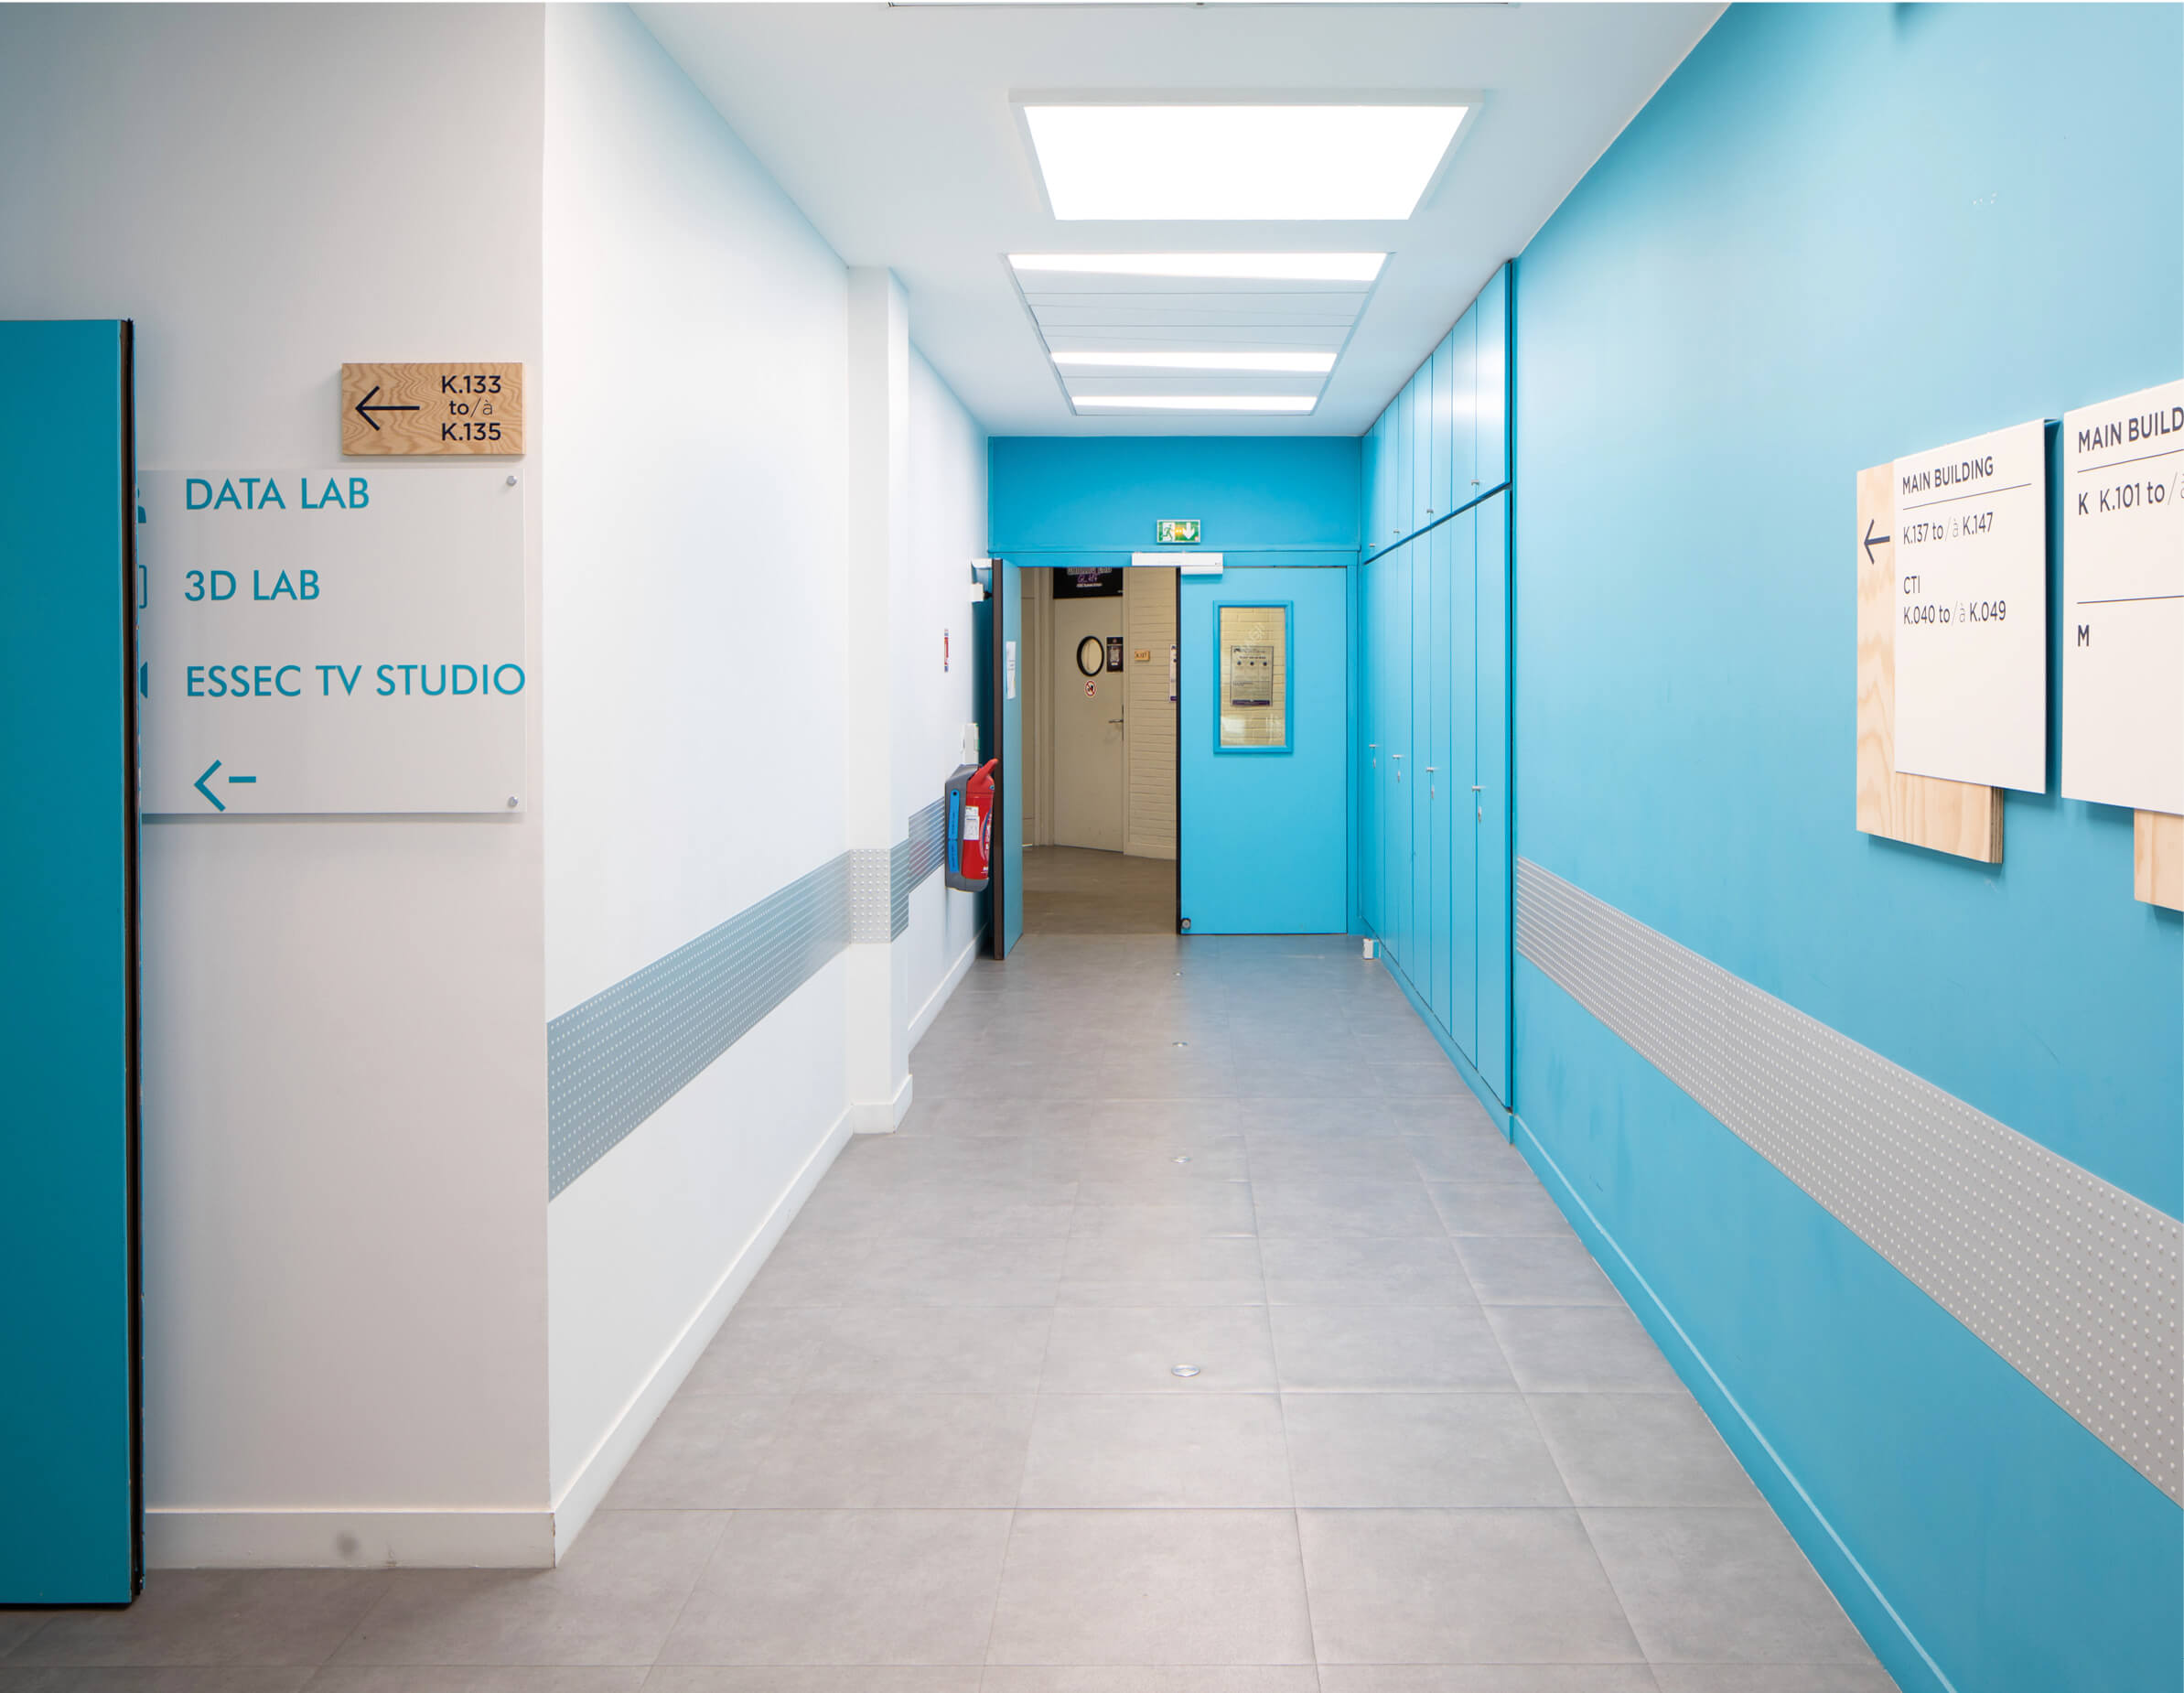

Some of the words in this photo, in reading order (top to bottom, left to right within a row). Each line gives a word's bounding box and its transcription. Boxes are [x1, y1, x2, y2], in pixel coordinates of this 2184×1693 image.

[441, 374, 501, 394] K.133
[441, 421, 501, 442] K.135
[2078, 420, 2123, 454] MAIN
[1902, 470, 1931, 495] MAIN
[1934, 455, 1995, 489] BUILDING
[186, 477, 286, 510] DATA
[300, 477, 371, 510] LAB
[2078, 491, 2090, 516] K
[2099, 481, 2140, 513] K.101
[1903, 522, 1930, 545] K.137
[1963, 511, 1994, 537] K.147
[184, 569, 237, 601] 3D
[253, 569, 320, 601] LAB
[1903, 575, 1921, 595] CTI
[1903, 604, 1936, 625] K.040
[1969, 599, 2006, 623] K.049
[2077, 624, 2091, 648] M
[187, 663, 301, 697] ESSEC
[315, 663, 362, 696] TV
[375, 663, 527, 696] STUDIO
